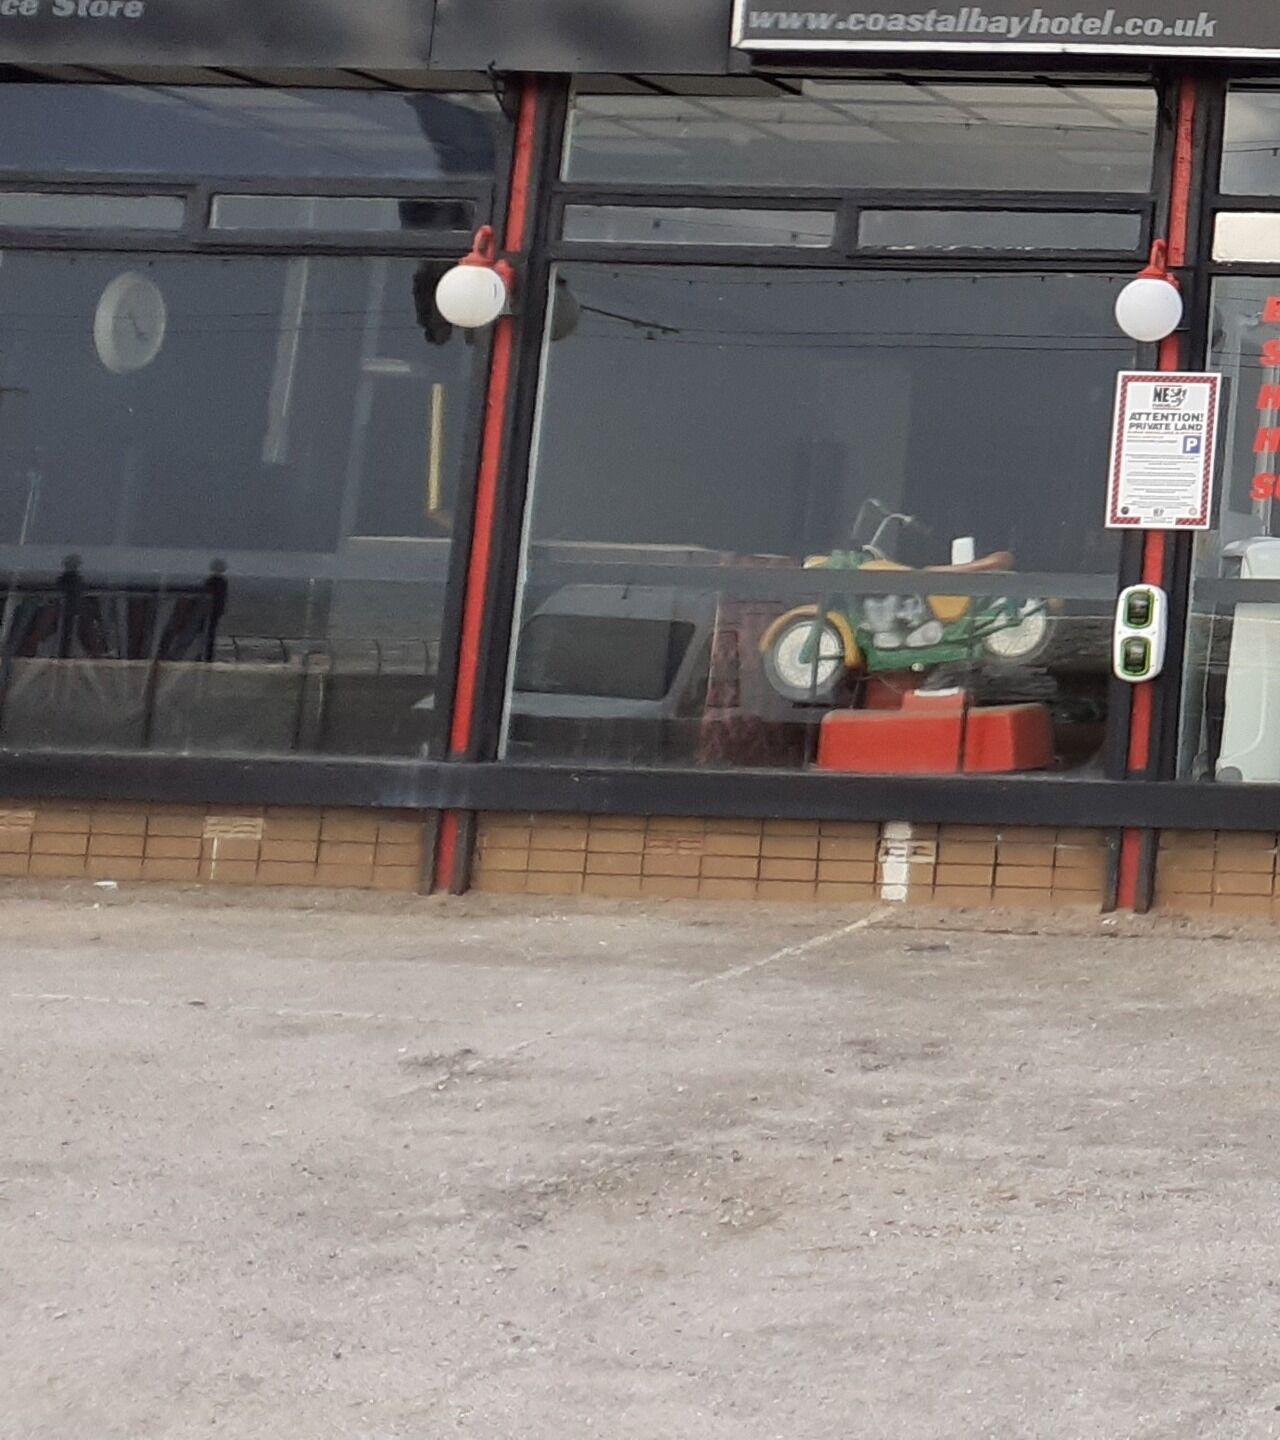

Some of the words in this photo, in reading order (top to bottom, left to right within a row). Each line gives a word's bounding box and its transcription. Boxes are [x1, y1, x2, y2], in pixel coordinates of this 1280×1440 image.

[748, 8, 1216, 38] www.coastalbayhotel.co.uk
[1129, 412, 1204, 422] ATTENTION!
[1128, 423, 1170, 431] PRIVATE
[1174, 423, 1203, 432] LAND
